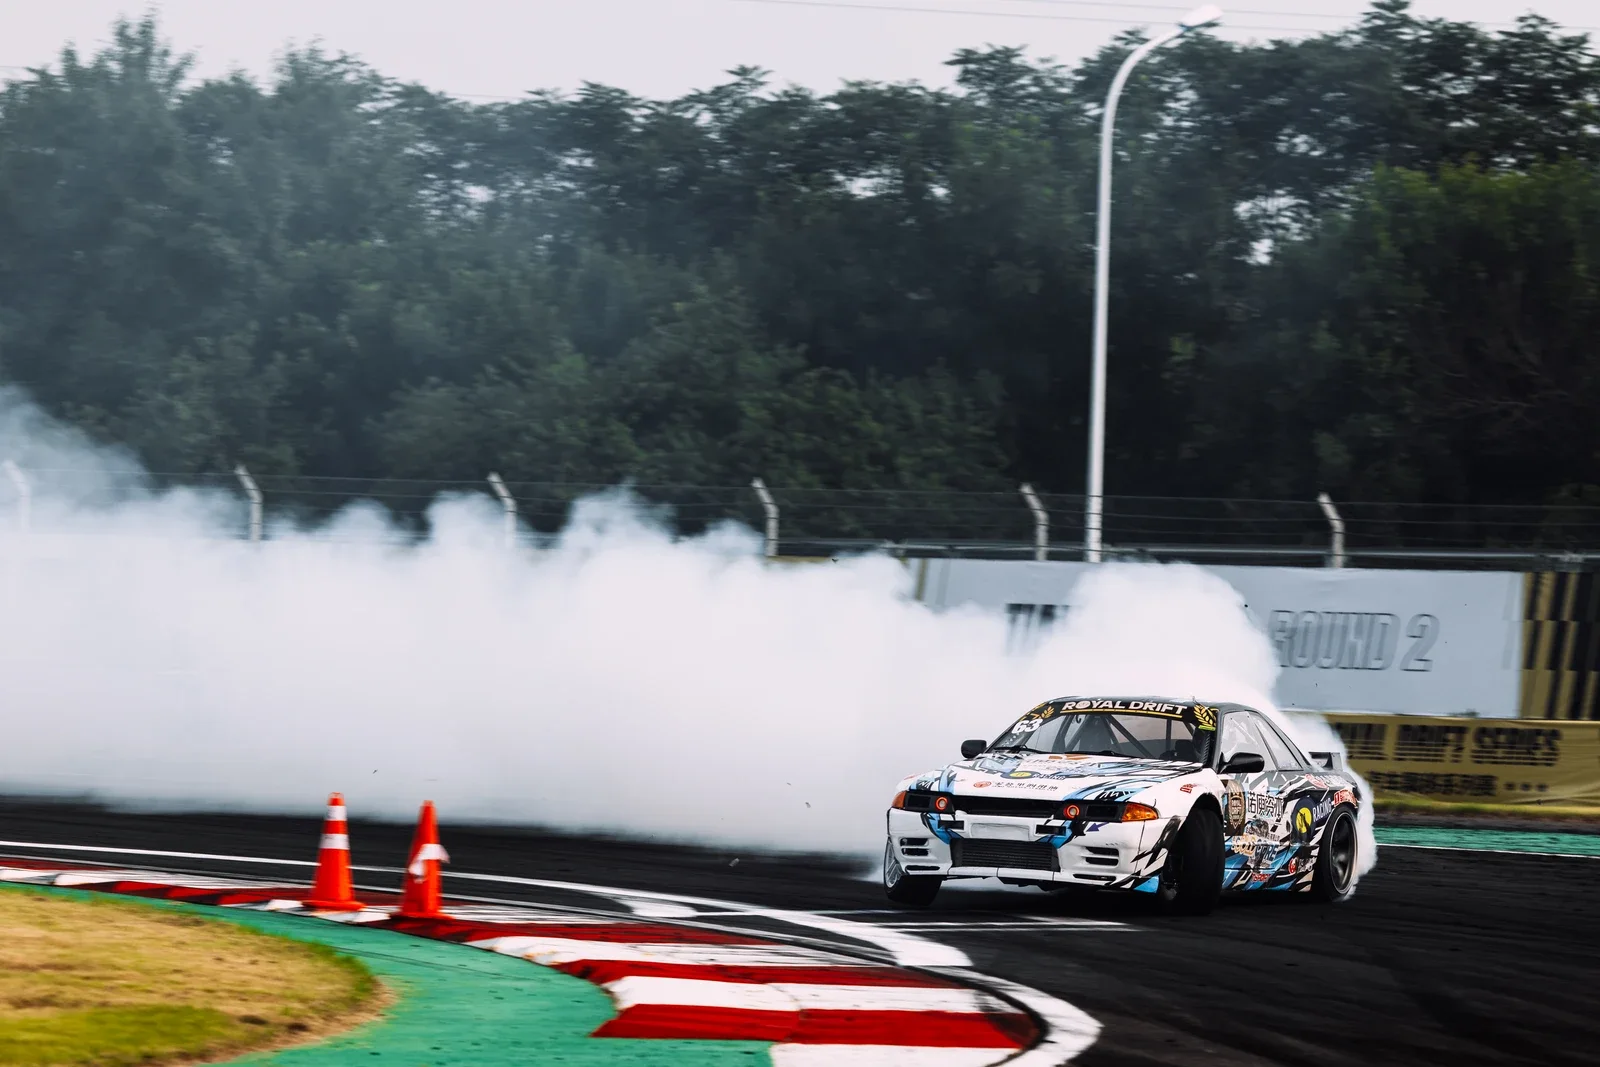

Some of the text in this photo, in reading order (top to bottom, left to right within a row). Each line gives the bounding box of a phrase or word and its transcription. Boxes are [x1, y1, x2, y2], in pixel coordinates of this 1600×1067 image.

[1268, 610, 1440, 672] ROUND 2
[1061, 699, 1187, 715] ROYAL DRIFT
[1011, 718, 1043, 734] 63
[1312, 798, 1332, 823] RACING
